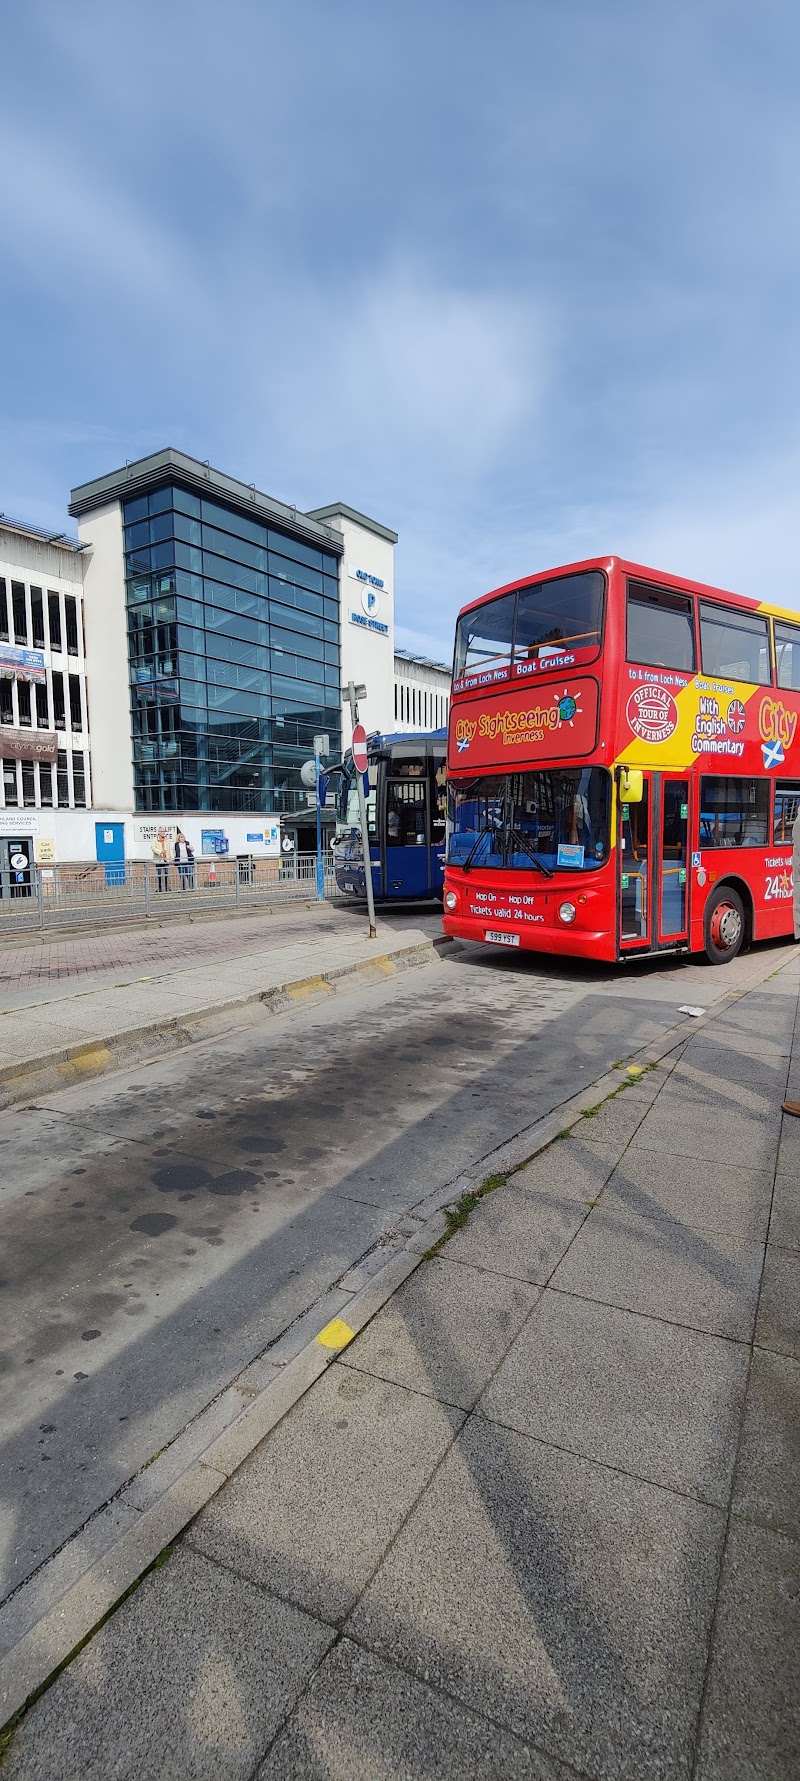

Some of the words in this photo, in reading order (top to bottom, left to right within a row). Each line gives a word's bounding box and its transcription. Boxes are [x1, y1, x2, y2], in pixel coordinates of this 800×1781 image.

[367, 593, 376, 607] P
[465, 678, 477, 687] from
[479, 672, 492, 684] Loch
[493, 670, 507, 680] Ness
[516, 661, 537, 675] Boat
[540, 654, 575, 669] Cruises
[629, 668, 637, 680] to
[638, 671, 643, 680] &
[644, 671, 659, 683] from
[660, 674, 674, 685] Loch
[675, 676, 688, 687] Ness
[695, 678, 710, 690] Boat
[712, 682, 735, 694] Cruises
[633, 686, 672, 708] OFFICIAL
[700, 696, 719, 716] With
[455, 718, 477, 742] City
[479, 706, 560, 739] Sightseeing
[638, 708, 658, 719] TOUR
[659, 709, 668, 720] OF
[758, 696, 798, 750] City
[502, 729, 544, 745] Inverness
[630, 716, 675, 741] INVERNESS
[695, 715, 726, 738] English
[691, 733, 745, 757] Commentary
[764, 857, 784, 868] Tickets
[476, 892, 487, 901] Hop
[488, 892, 497, 901] On
[508, 895, 522, 905] Hop
[523, 895, 534, 905] Off
[764, 875, 780, 900] 24
[469, 904, 493, 916] Tickets
[494, 908, 512, 919] valid
[514, 909, 523, 920] 24
[524, 912, 545, 922] hours
[503, 934, 515, 944] YST
